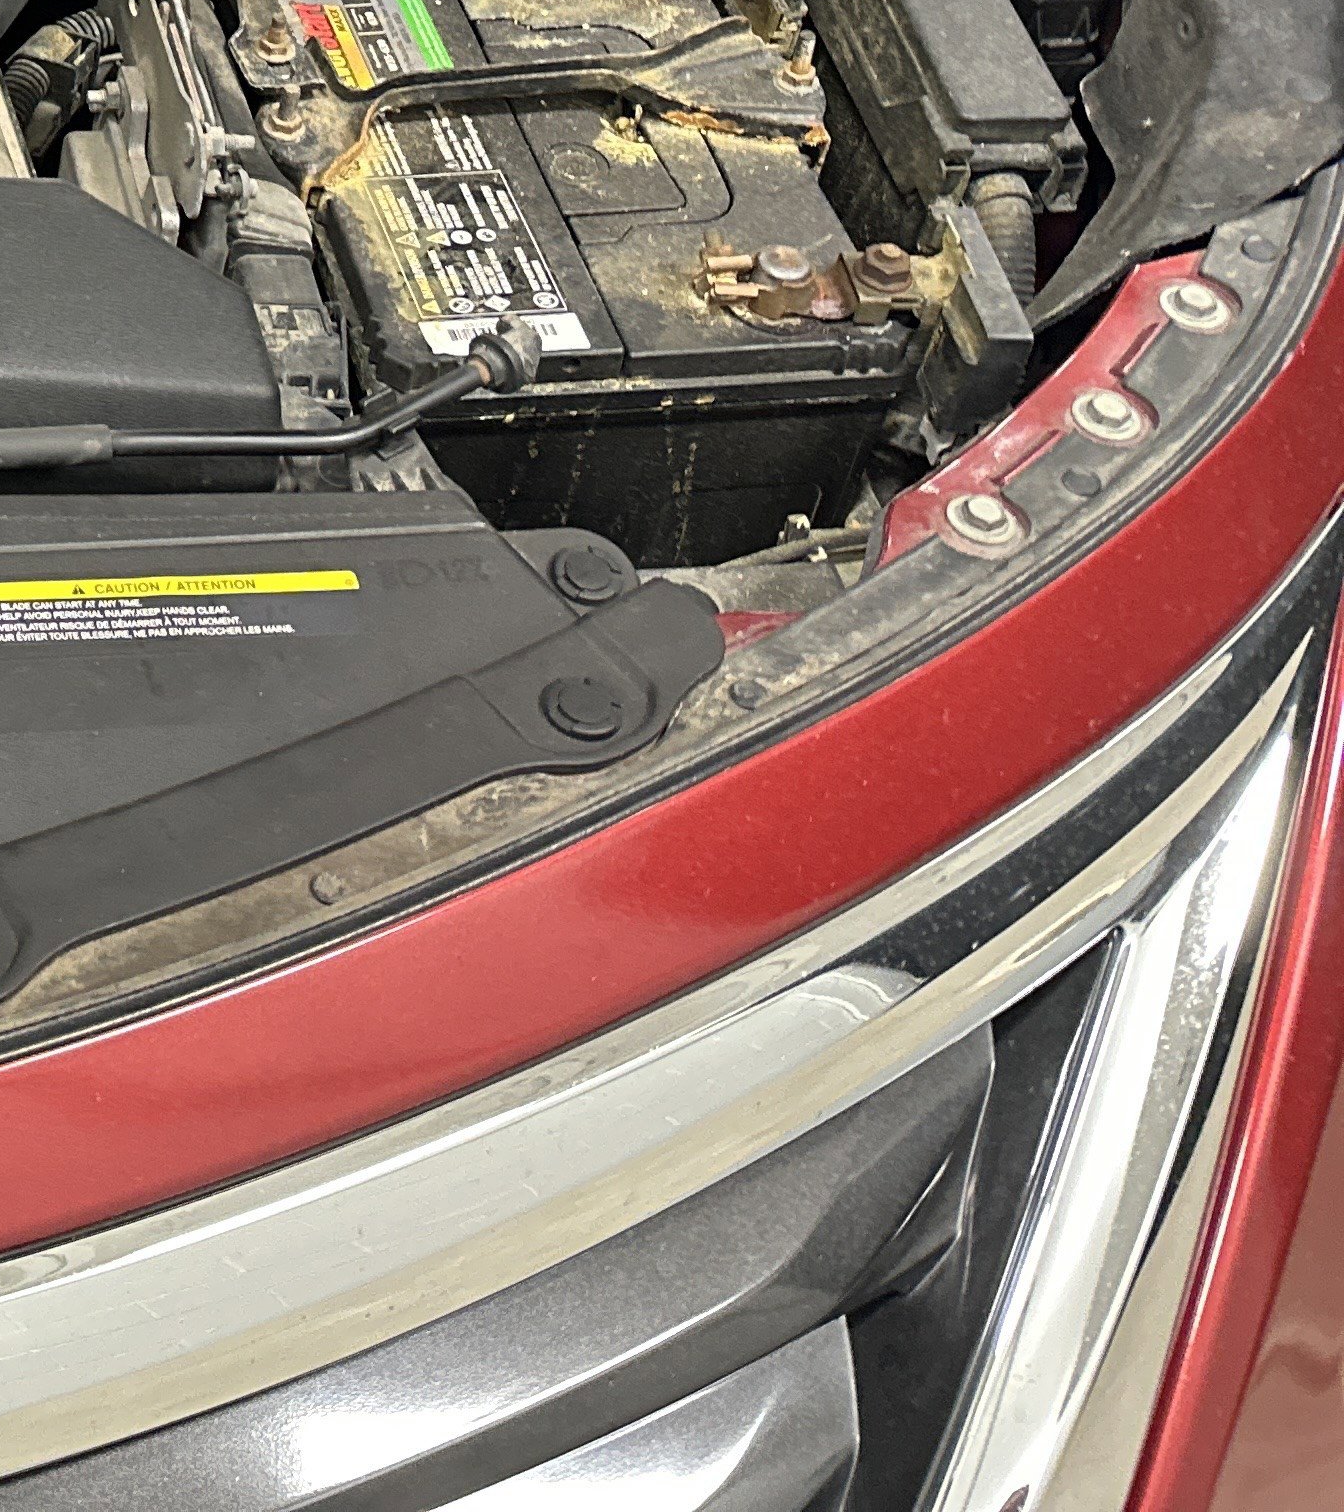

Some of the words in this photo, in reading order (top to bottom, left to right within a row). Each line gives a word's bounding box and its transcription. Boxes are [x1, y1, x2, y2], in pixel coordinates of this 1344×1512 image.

[94, 582, 160, 594] CAUTION
[177, 579, 256, 591] ATTENTION
[0, 602, 31, 611] BLADE
[32, 601, 53, 610] CAN
[54, 600, 83, 609] START
[85, 600, 95, 608] AT
[98, 599, 116, 608] ANY
[117, 598, 142, 607] TIME.
[23, 611, 52, 620] AVOID
[53, 609, 103, 619] PERSONAL
[162, 606, 195, 615] HANDS
[196, 605, 231, 615] CLEAR.
[59, 620, 95, 630] RISQUE
[96, 620, 110, 629] DE
[110, 618, 163, 628] DÉMARRER
[172, 617, 197, 626] TOUT
[198, 615, 242, 625] MOMENT.
[16, 631, 48, 642] ÉVITER
[48, 631, 80, 641] TOUTE
[80, 629, 132, 640] BLESSURE,
[133, 629, 147, 638] NE
[148, 628, 167, 637] PAS
[168, 627, 182, 636] EN
[184, 626, 243, 636] APPROCHER
[243, 625, 261, 635] LES
[262, 624, 295, 634] MAINS.
